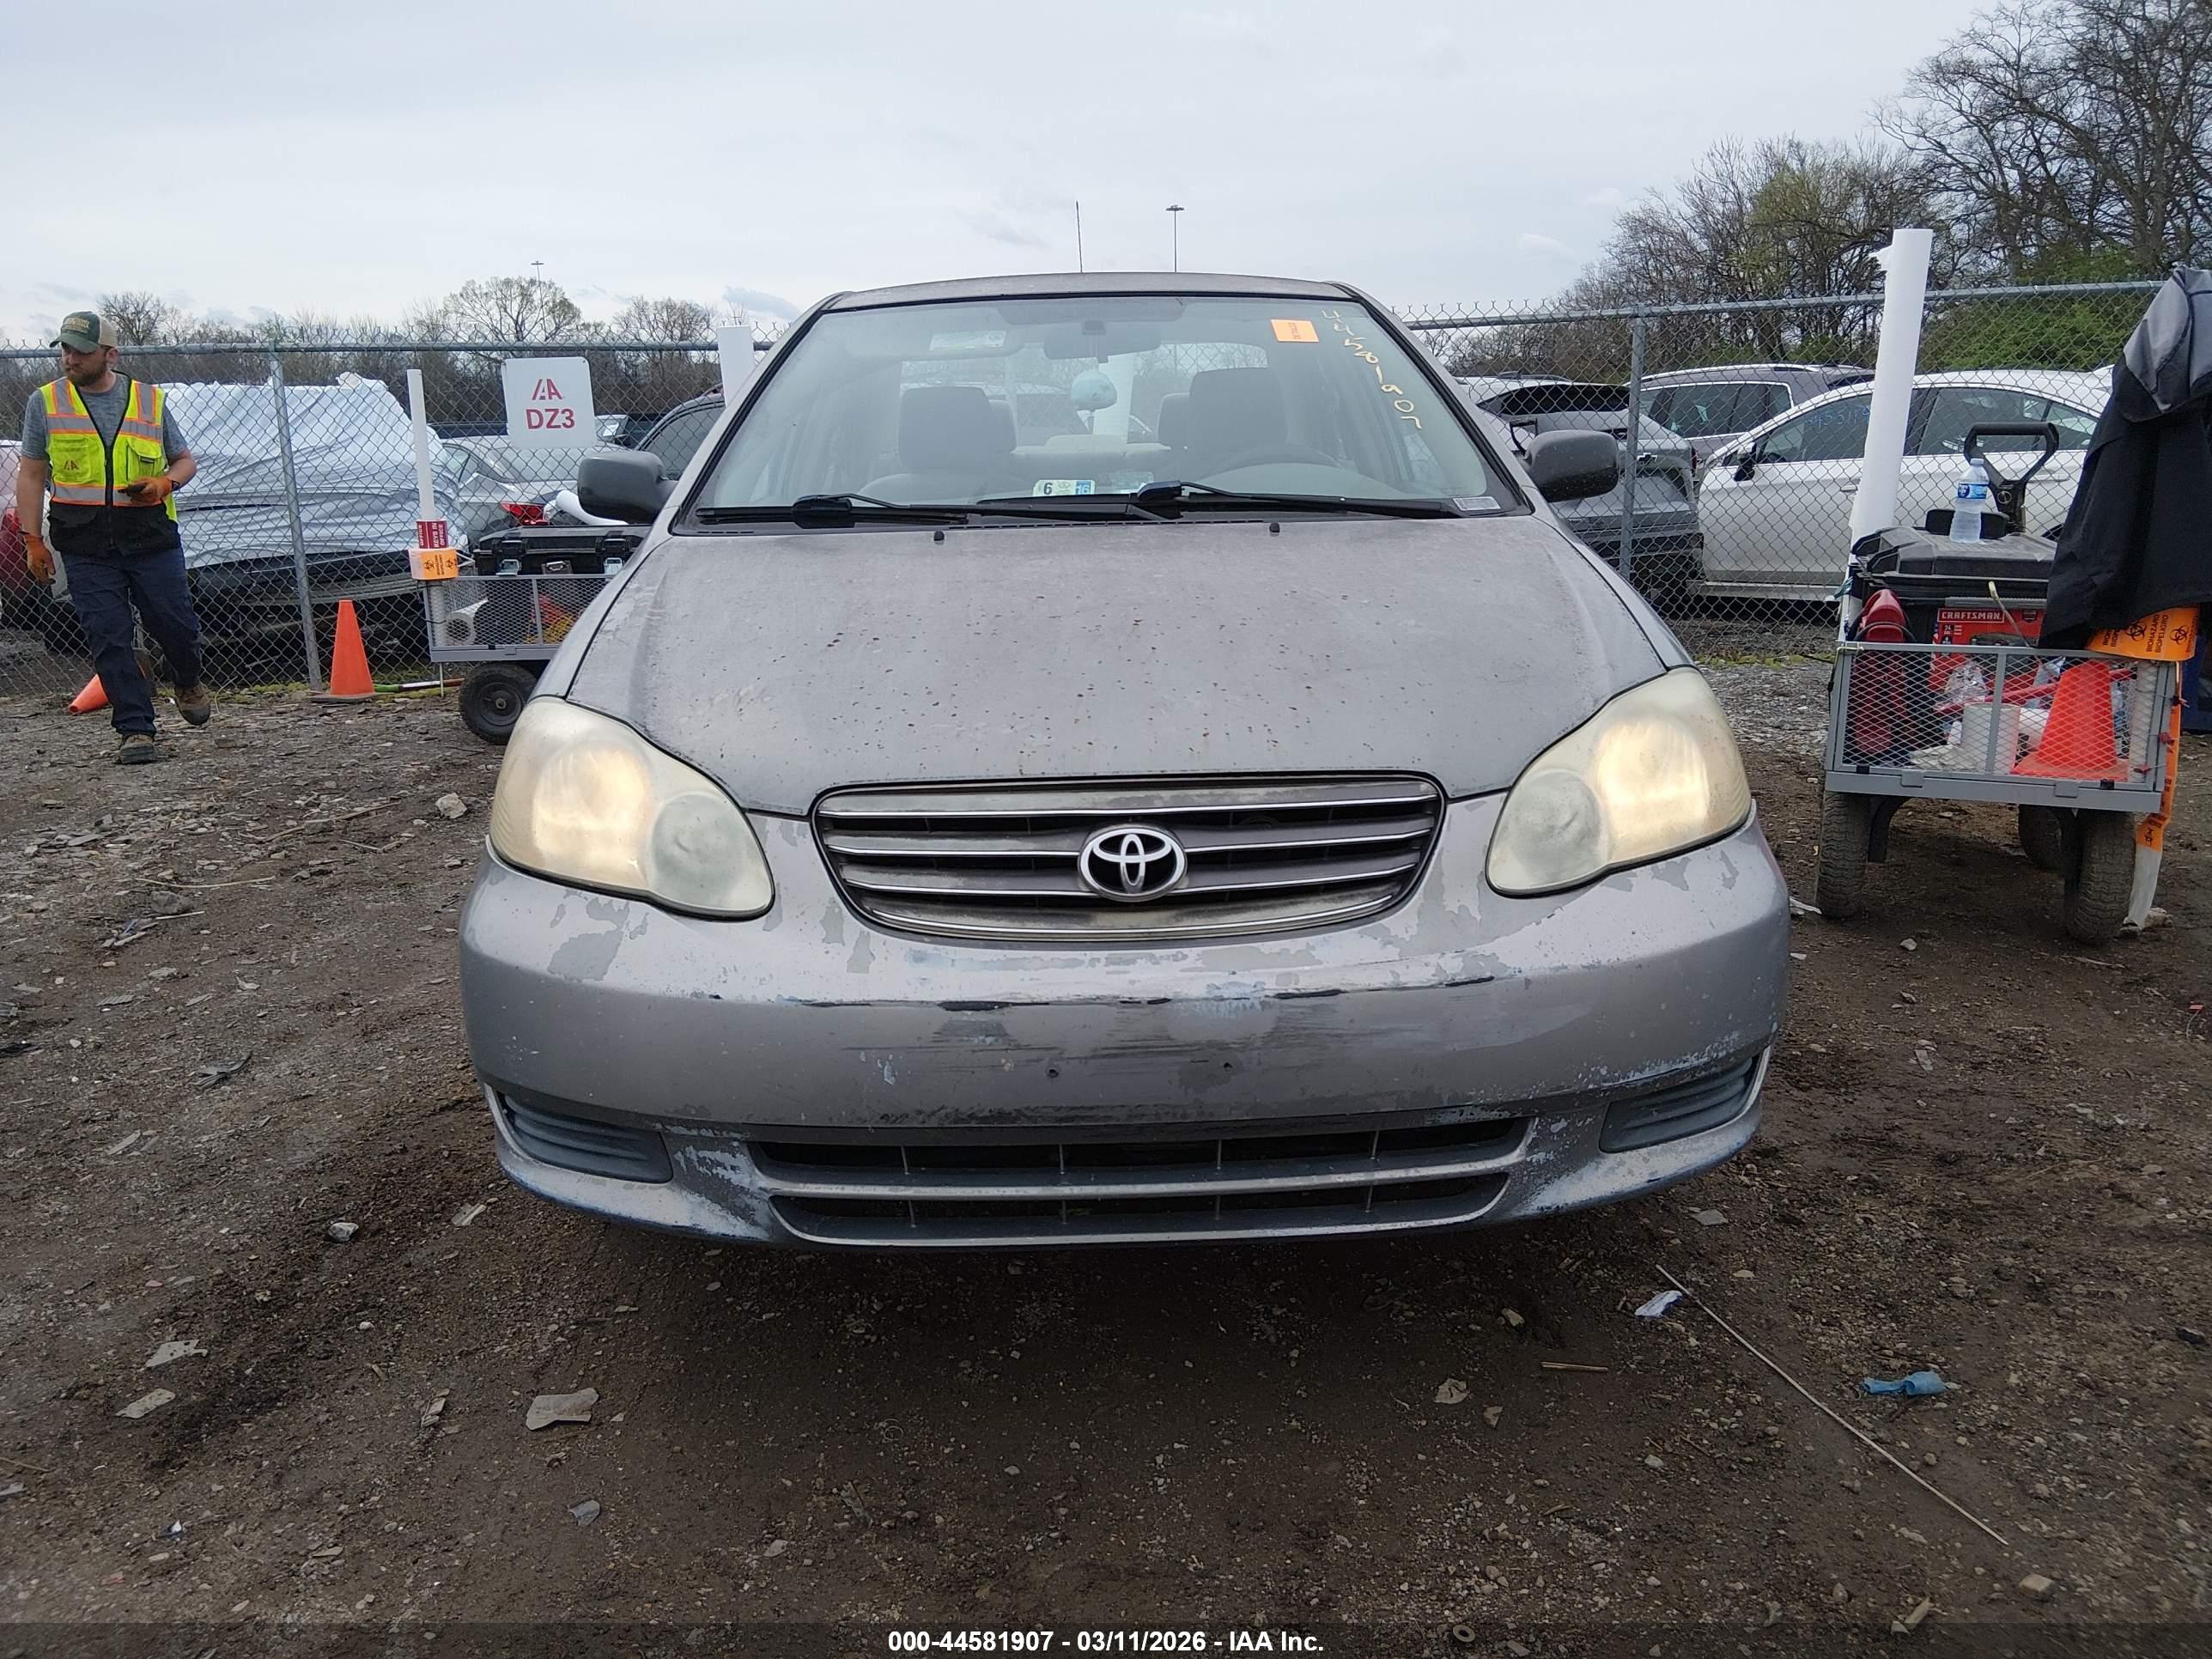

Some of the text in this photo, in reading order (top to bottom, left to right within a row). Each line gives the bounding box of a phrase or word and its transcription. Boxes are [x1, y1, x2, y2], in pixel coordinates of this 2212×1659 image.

[526, 408, 575, 429] DZ3
[1043, 482, 1053, 495] 6
[1942, 611, 2001, 620] CRAFTSMAN
[2146, 614, 2160, 652] BIOHAZARD
[2154, 614, 2169, 653] BIOPELIGRO
